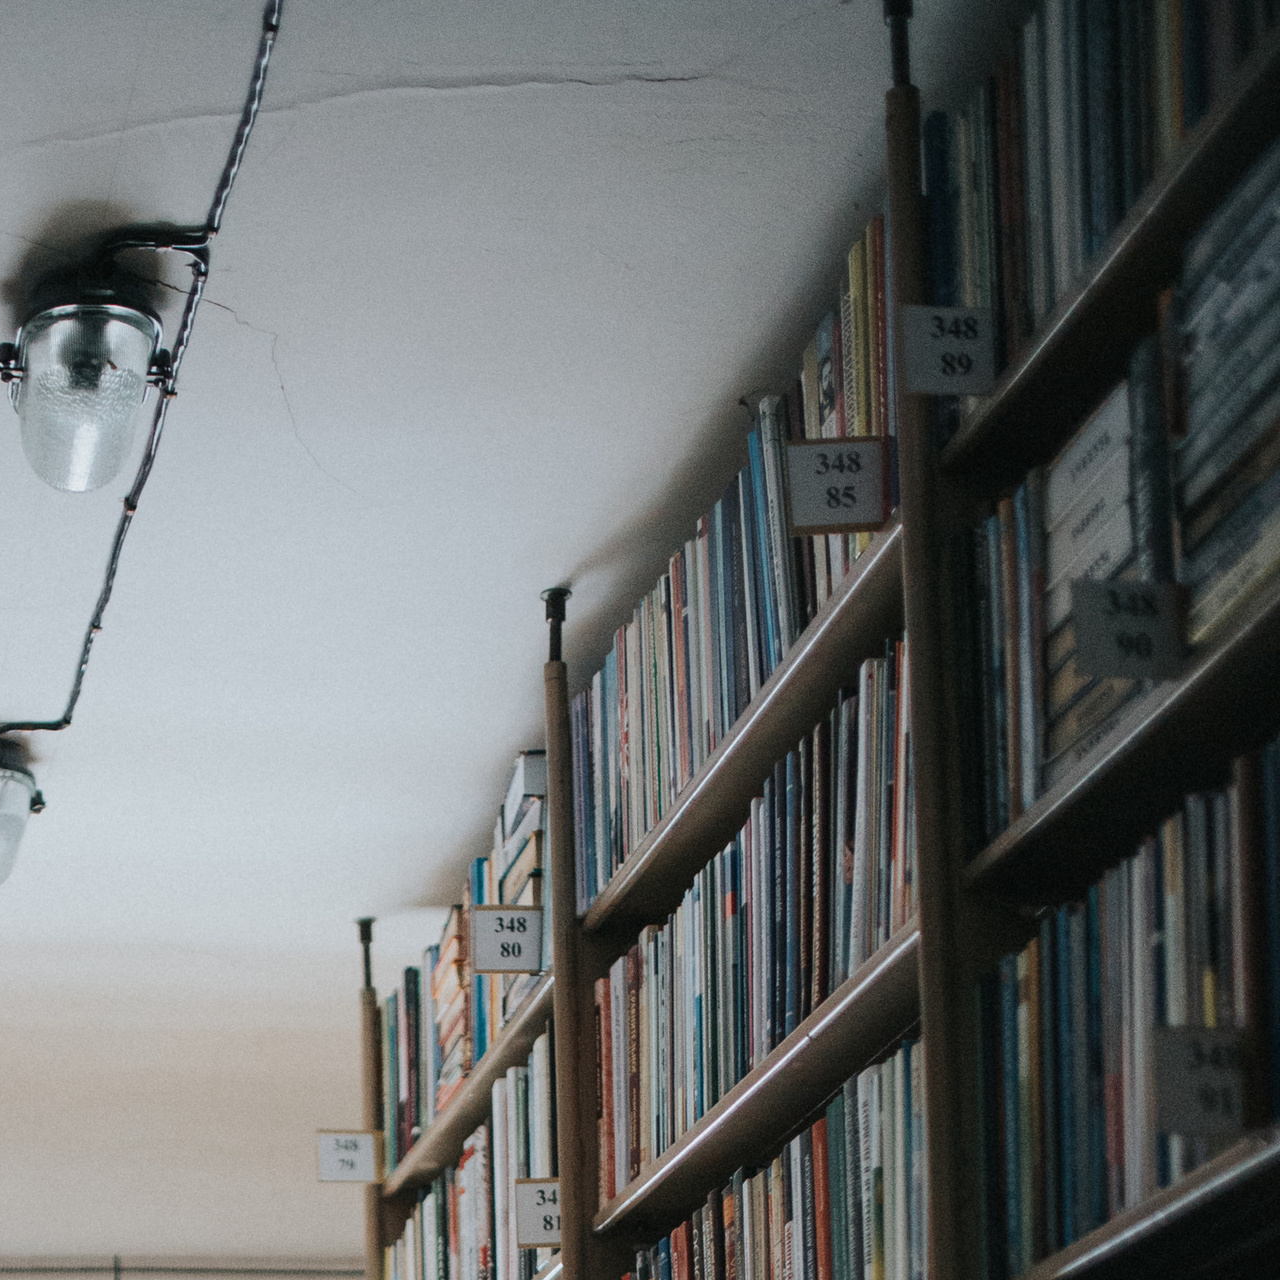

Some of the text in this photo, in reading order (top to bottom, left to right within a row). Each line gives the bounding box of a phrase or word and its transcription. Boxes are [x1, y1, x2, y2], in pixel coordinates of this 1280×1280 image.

[929, 315, 979, 341] 348
[939, 351, 974, 377] 89
[814, 451, 862, 477] 348
[825, 485, 858, 510] 85
[1105, 590, 1159, 618] 348
[493, 916, 528, 934] 348
[500, 940, 522, 959] 80
[333, 1138, 359, 1154] 348
[337, 1156, 357, 1172] 79
[536, 1189, 559, 1207] 34
[543, 1213, 561, 1232] 81
